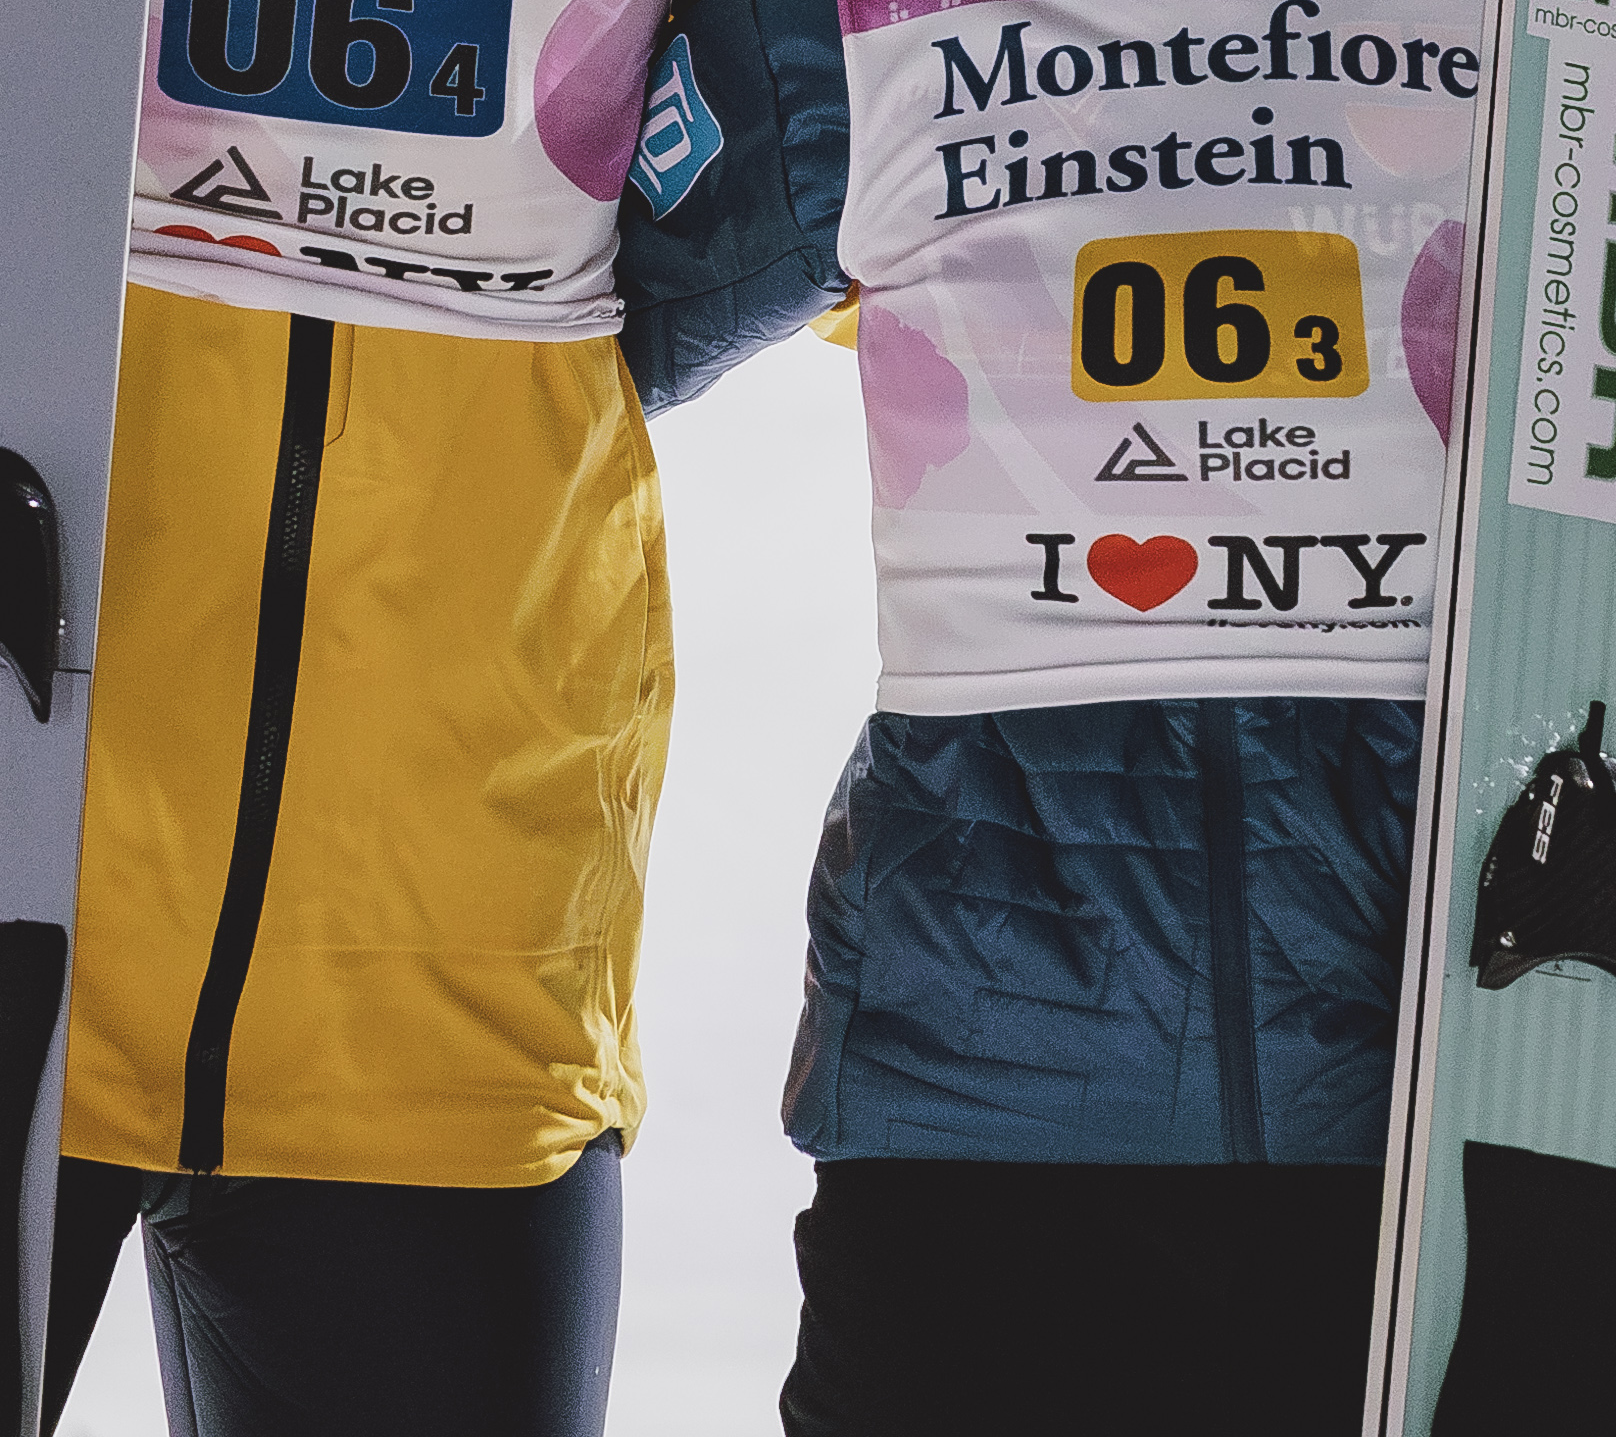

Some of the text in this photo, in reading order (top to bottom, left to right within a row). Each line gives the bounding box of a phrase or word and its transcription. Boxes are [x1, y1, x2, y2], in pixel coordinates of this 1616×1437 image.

[301, 155, 436, 204] Lake
[933, 105, 1353, 222] Einstein
[295, 197, 475, 238] Placid
[1525, 57, 1591, 490] mbr-cosmetics.com
[1198, 418, 1317, 450] Lake
[1199, 447, 1351, 483] Placid
[1025, 533, 1080, 604] I
